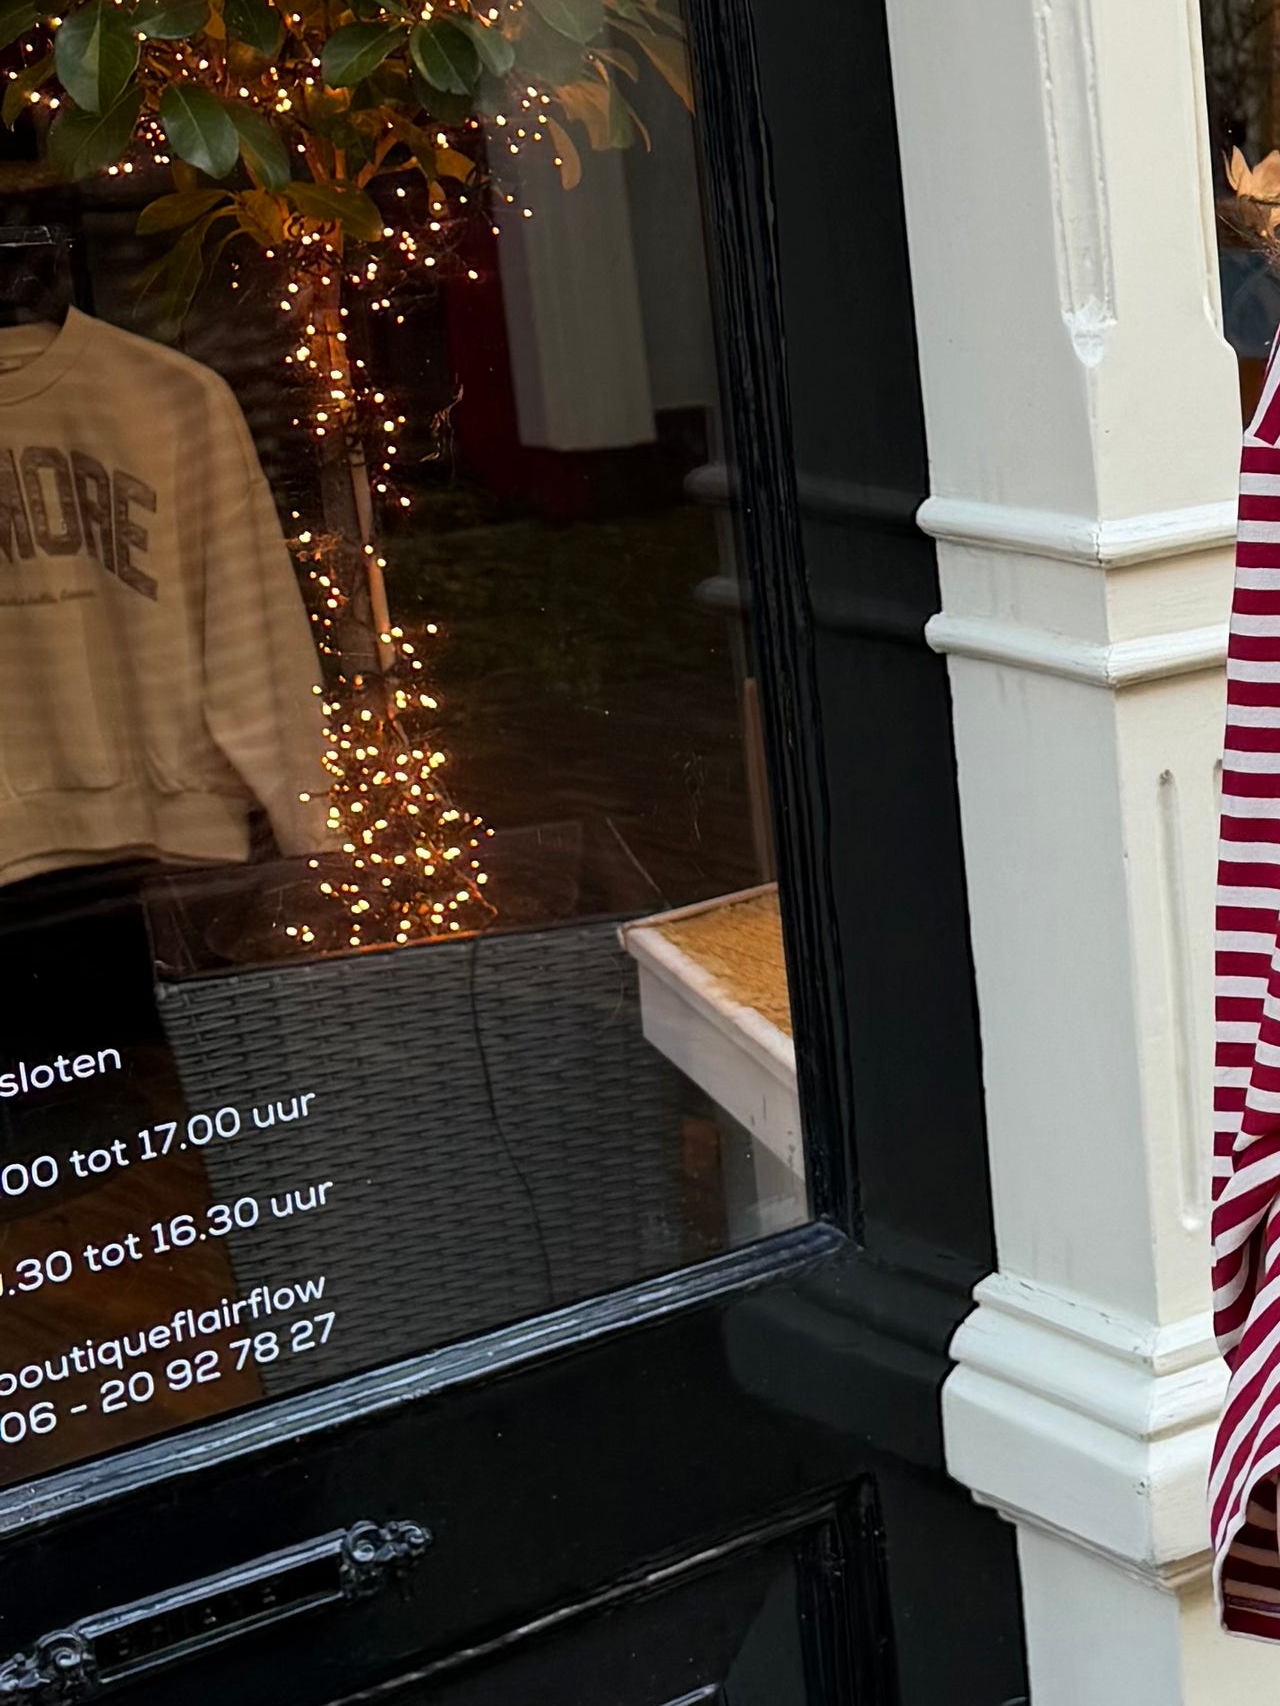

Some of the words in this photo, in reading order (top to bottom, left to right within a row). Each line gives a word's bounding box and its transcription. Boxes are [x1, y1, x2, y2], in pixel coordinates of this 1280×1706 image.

[0, 1048, 121, 1097] sloten
[69, 1139, 129, 1177] tot
[138, 1106, 241, 1160] 17.00
[252, 1092, 316, 1128] uur
[83, 1233, 143, 1272] tot
[151, 1197, 259, 1254] 16.30
[270, 1181, 333, 1218] uur
[0, 1401, 57, 1443] 06
[100, 1370, 155, 1414] 20
[166, 1349, 221, 1391] 92
[229, 1331, 280, 1371] 78
[290, 1310, 336, 1353] 27
